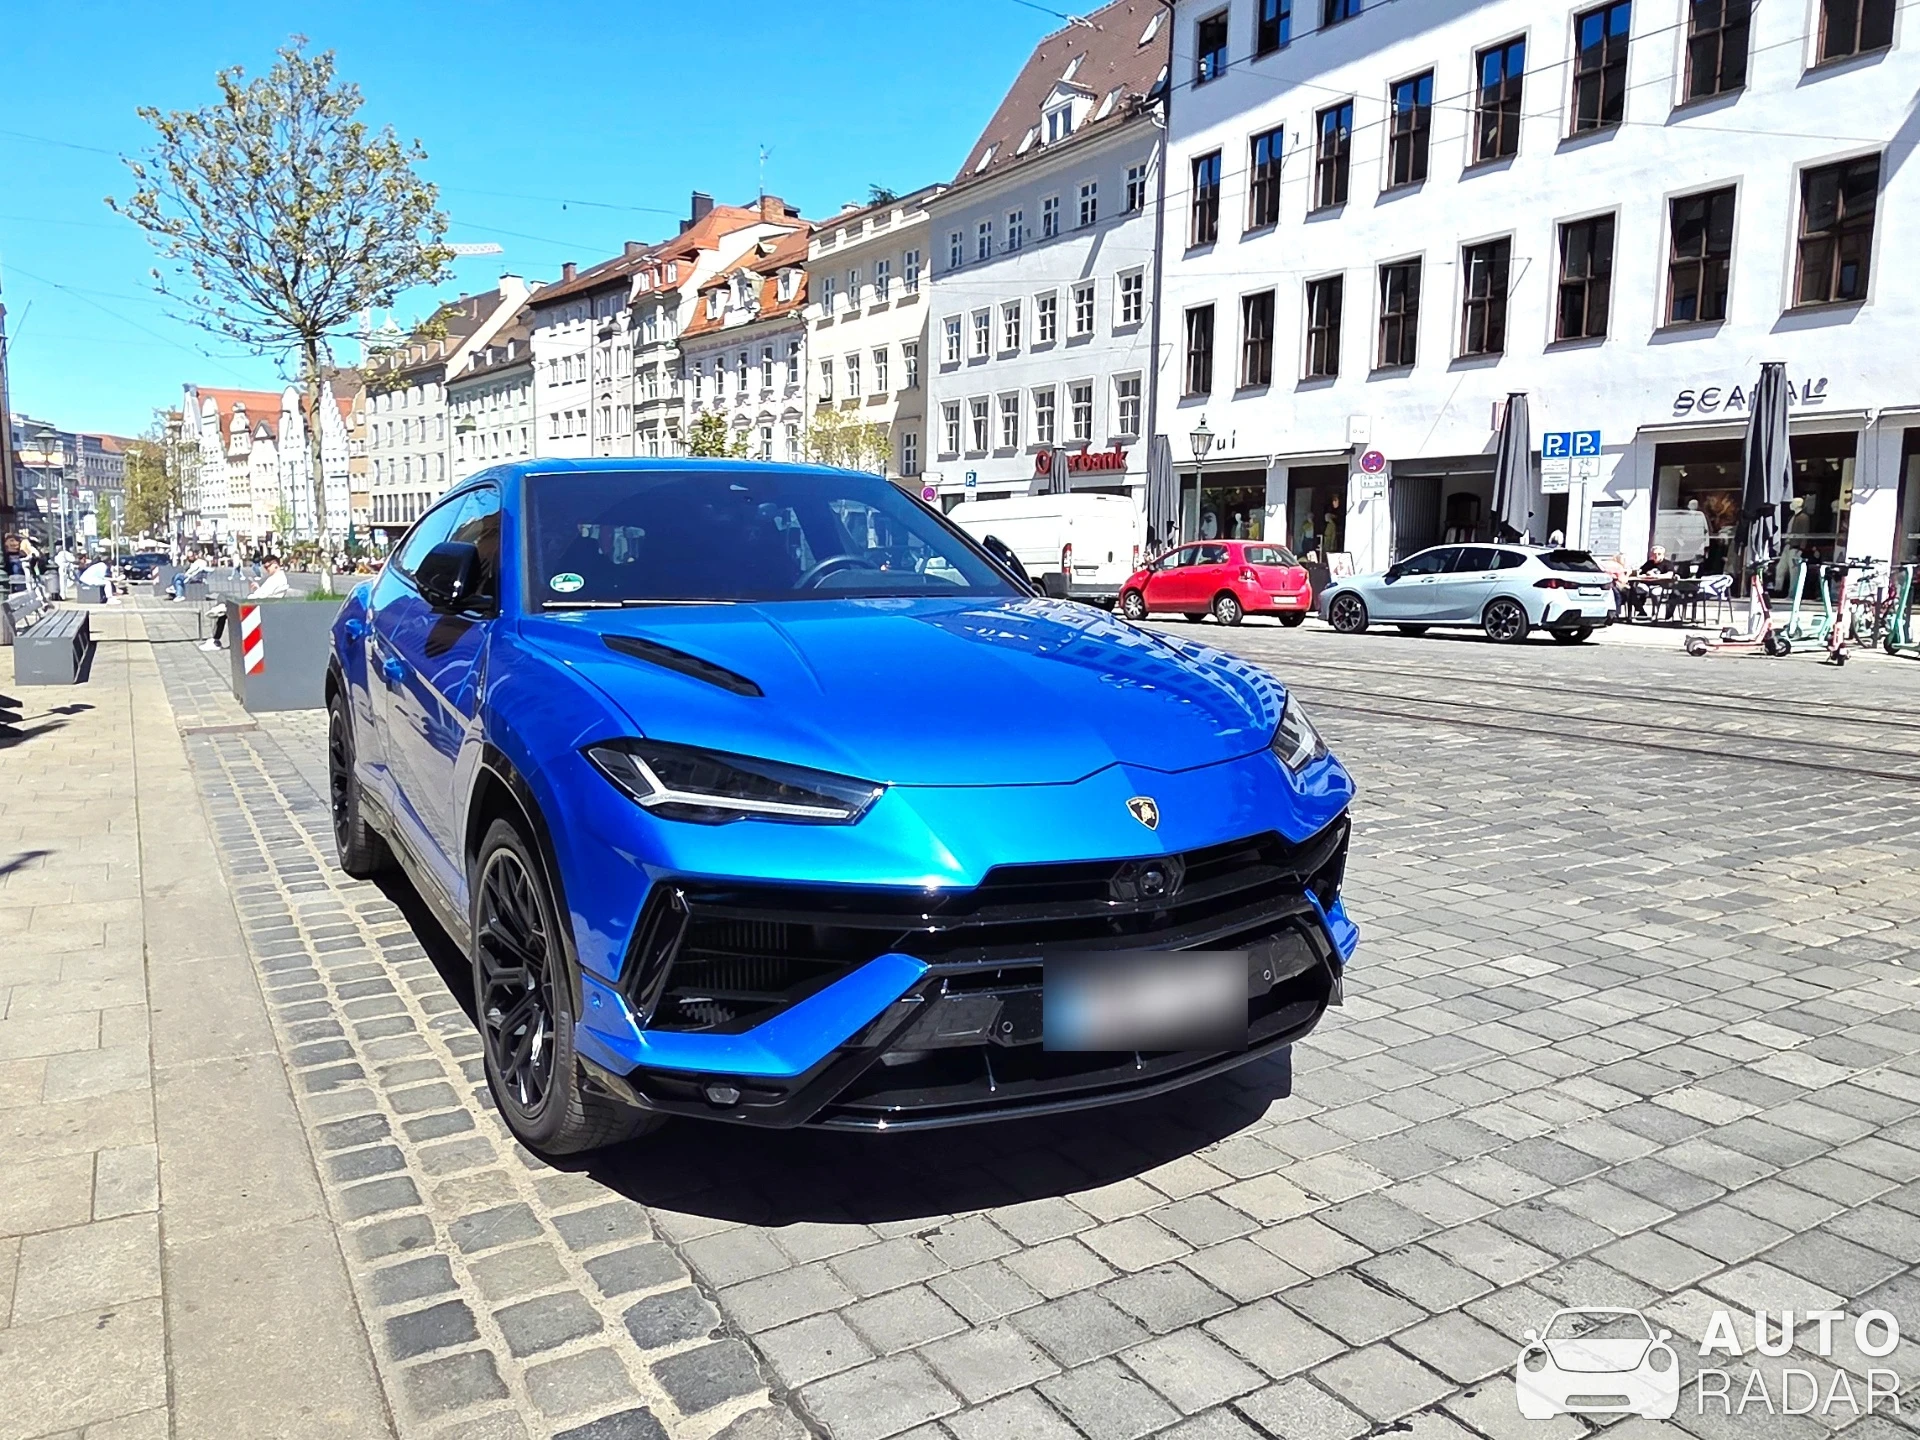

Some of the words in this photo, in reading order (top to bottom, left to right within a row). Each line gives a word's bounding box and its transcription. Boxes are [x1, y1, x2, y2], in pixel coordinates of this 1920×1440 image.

[1675, 378, 1827, 410] SCAAL
[1546, 435, 1563, 455] P
[1576, 433, 1592, 454] P
